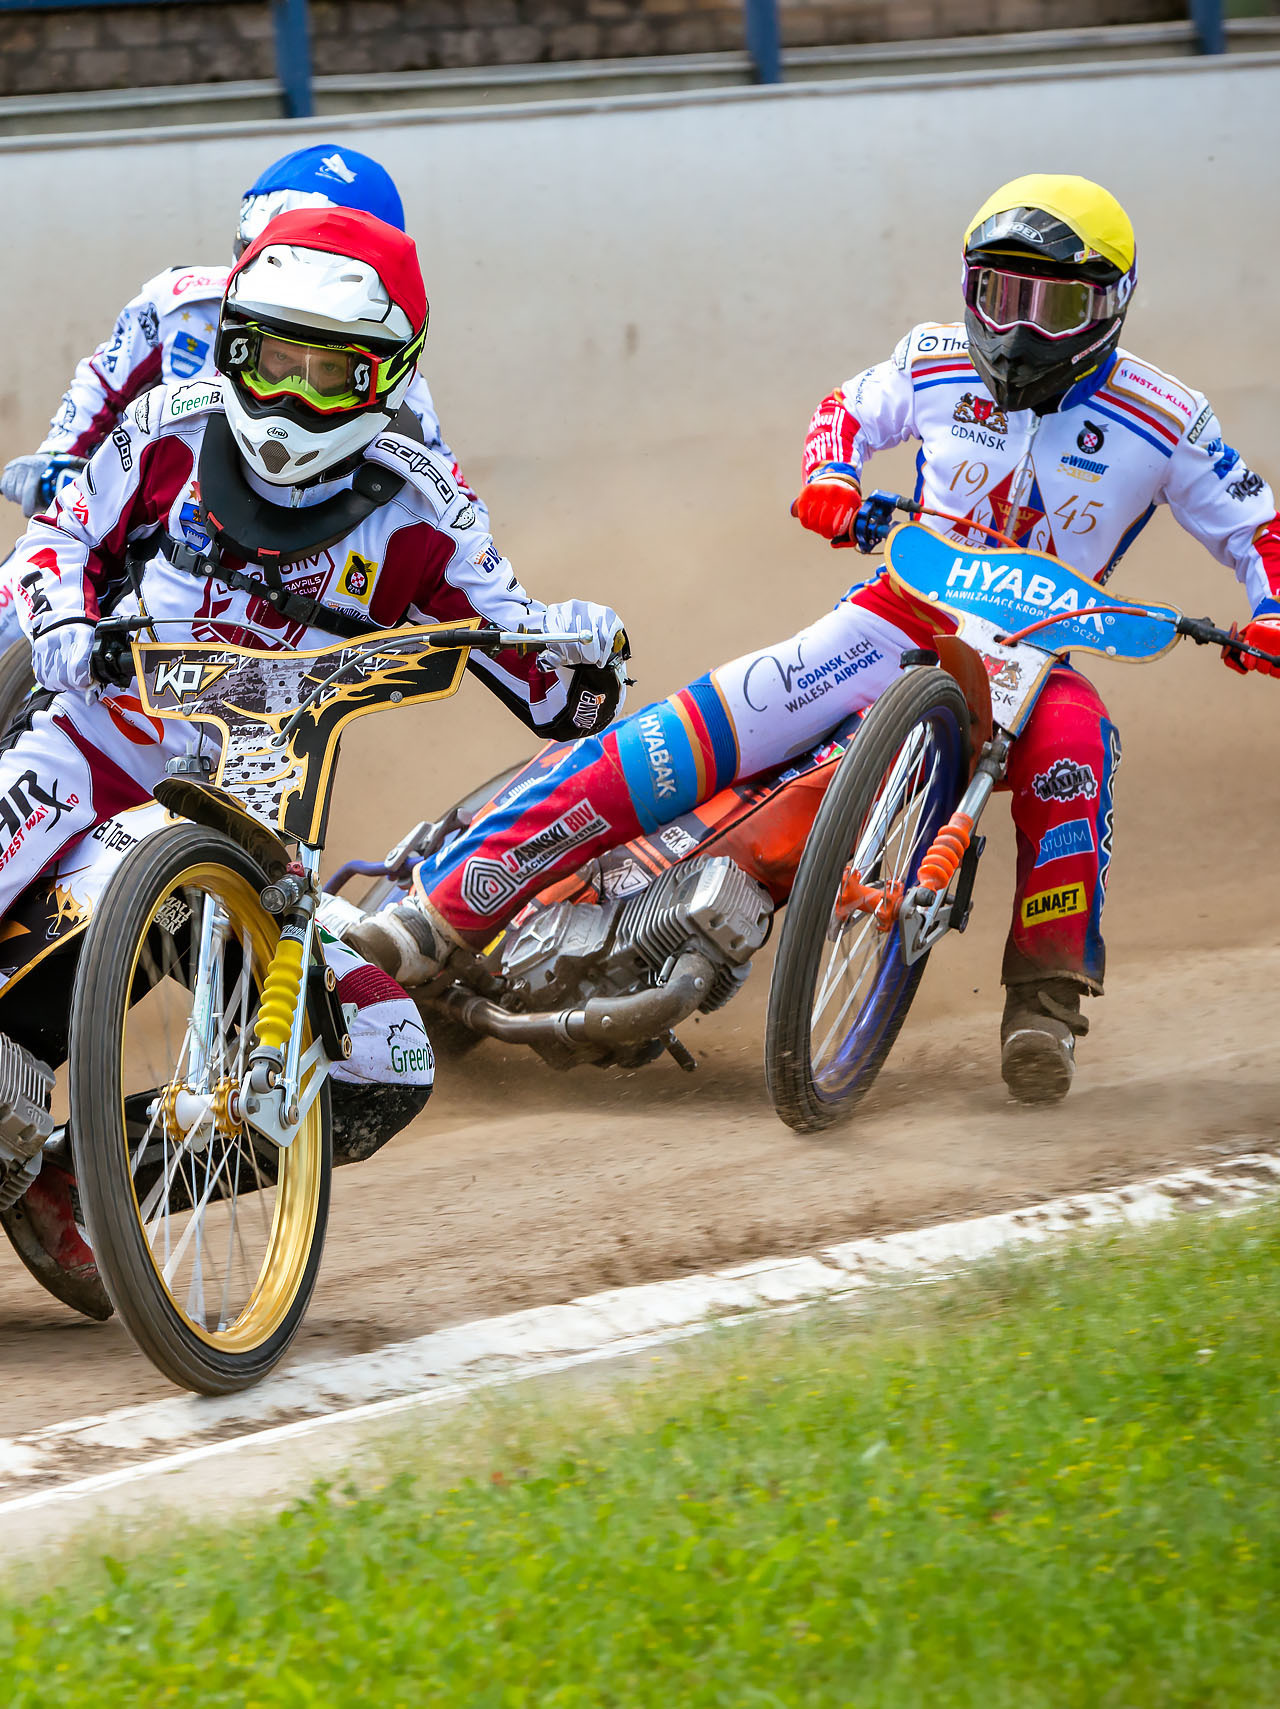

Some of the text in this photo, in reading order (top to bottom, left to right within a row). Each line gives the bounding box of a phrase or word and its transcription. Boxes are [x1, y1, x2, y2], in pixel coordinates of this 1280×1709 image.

[171, 391, 224, 416] GreenB
[1128, 372, 1193, 418] INSTAL-KLIMA
[269, 427, 287, 438] Arai
[951, 424, 1007, 452] GDAŃSK
[949, 460, 989, 497] 19
[1053, 495, 1105, 535] 45
[946, 557, 1105, 635] HYABAK
[797, 638, 875, 691] GDANSK LECH
[785, 680, 834, 714] WALESA
[638, 712, 677, 799] HYABAK
[1039, 768, 1093, 797] MAXIMA
[24, 804, 50, 832] WAY
[64, 792, 81, 808] TO
[1026, 888, 1080, 918] ELNAFT
